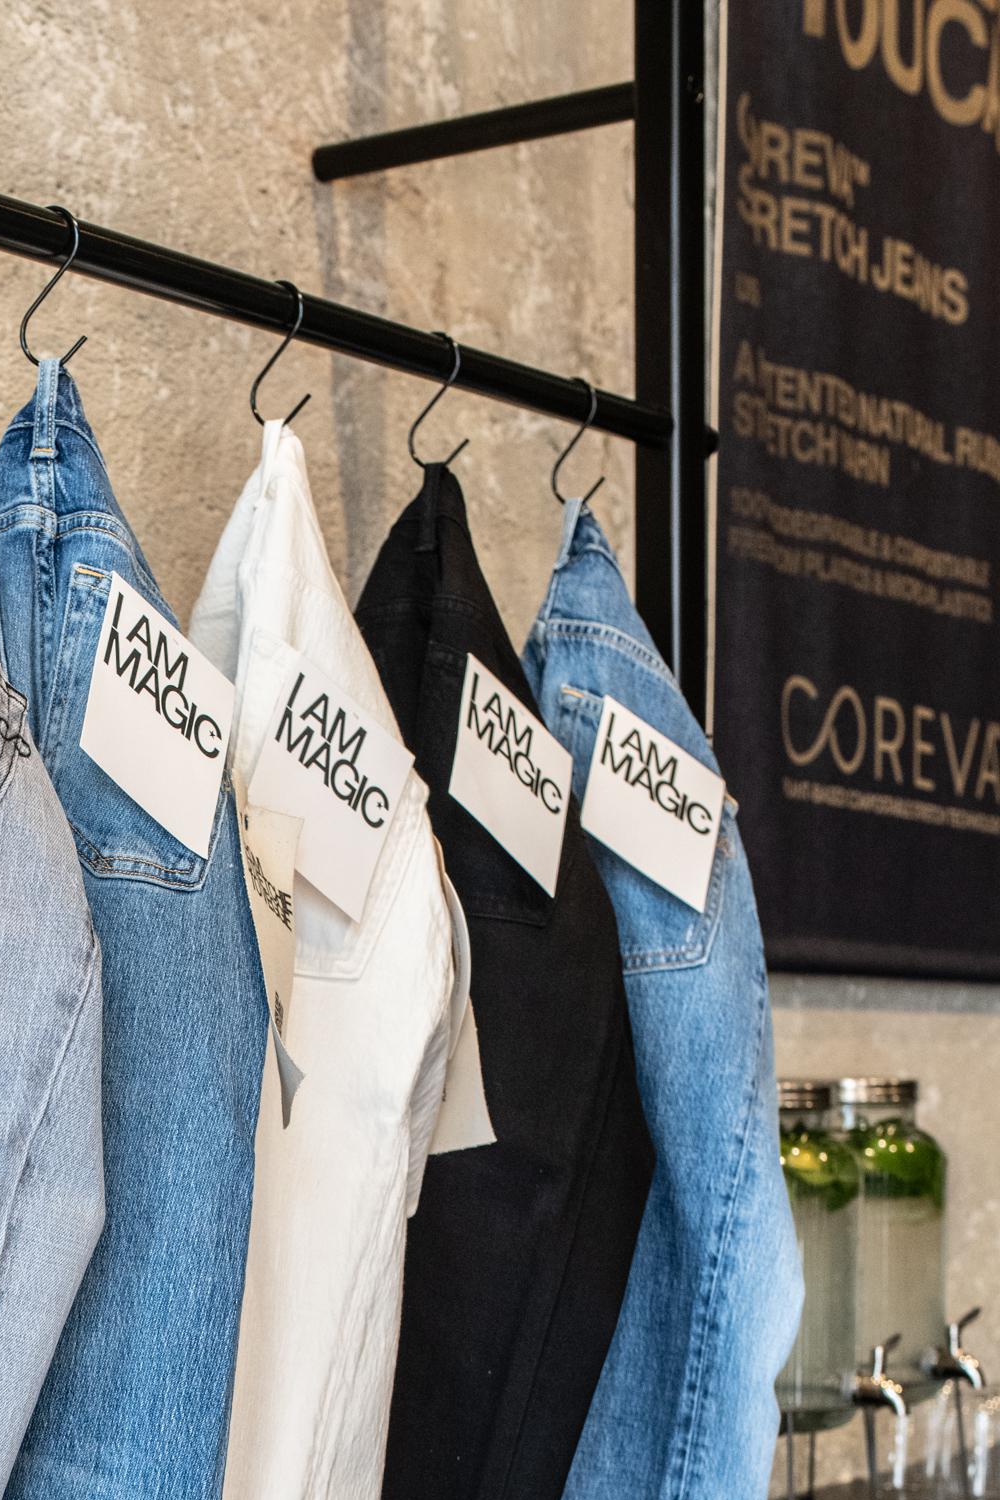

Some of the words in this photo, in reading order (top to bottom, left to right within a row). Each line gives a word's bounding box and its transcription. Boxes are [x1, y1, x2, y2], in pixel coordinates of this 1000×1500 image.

[112, 592, 124, 630] I
[126, 614, 189, 691] AM
[103, 626, 222, 758] MAGIC
[287, 672, 305, 709] I
[300, 693, 367, 765] AM
[471, 672, 479, 700] I
[482, 692, 533, 757] AM
[275, 707, 389, 828] MAGIC
[467, 701, 562, 814] MAGIC
[600, 739, 712, 835] MAGIC
[607, 712, 615, 738] I
[620, 728, 678, 785] AM
